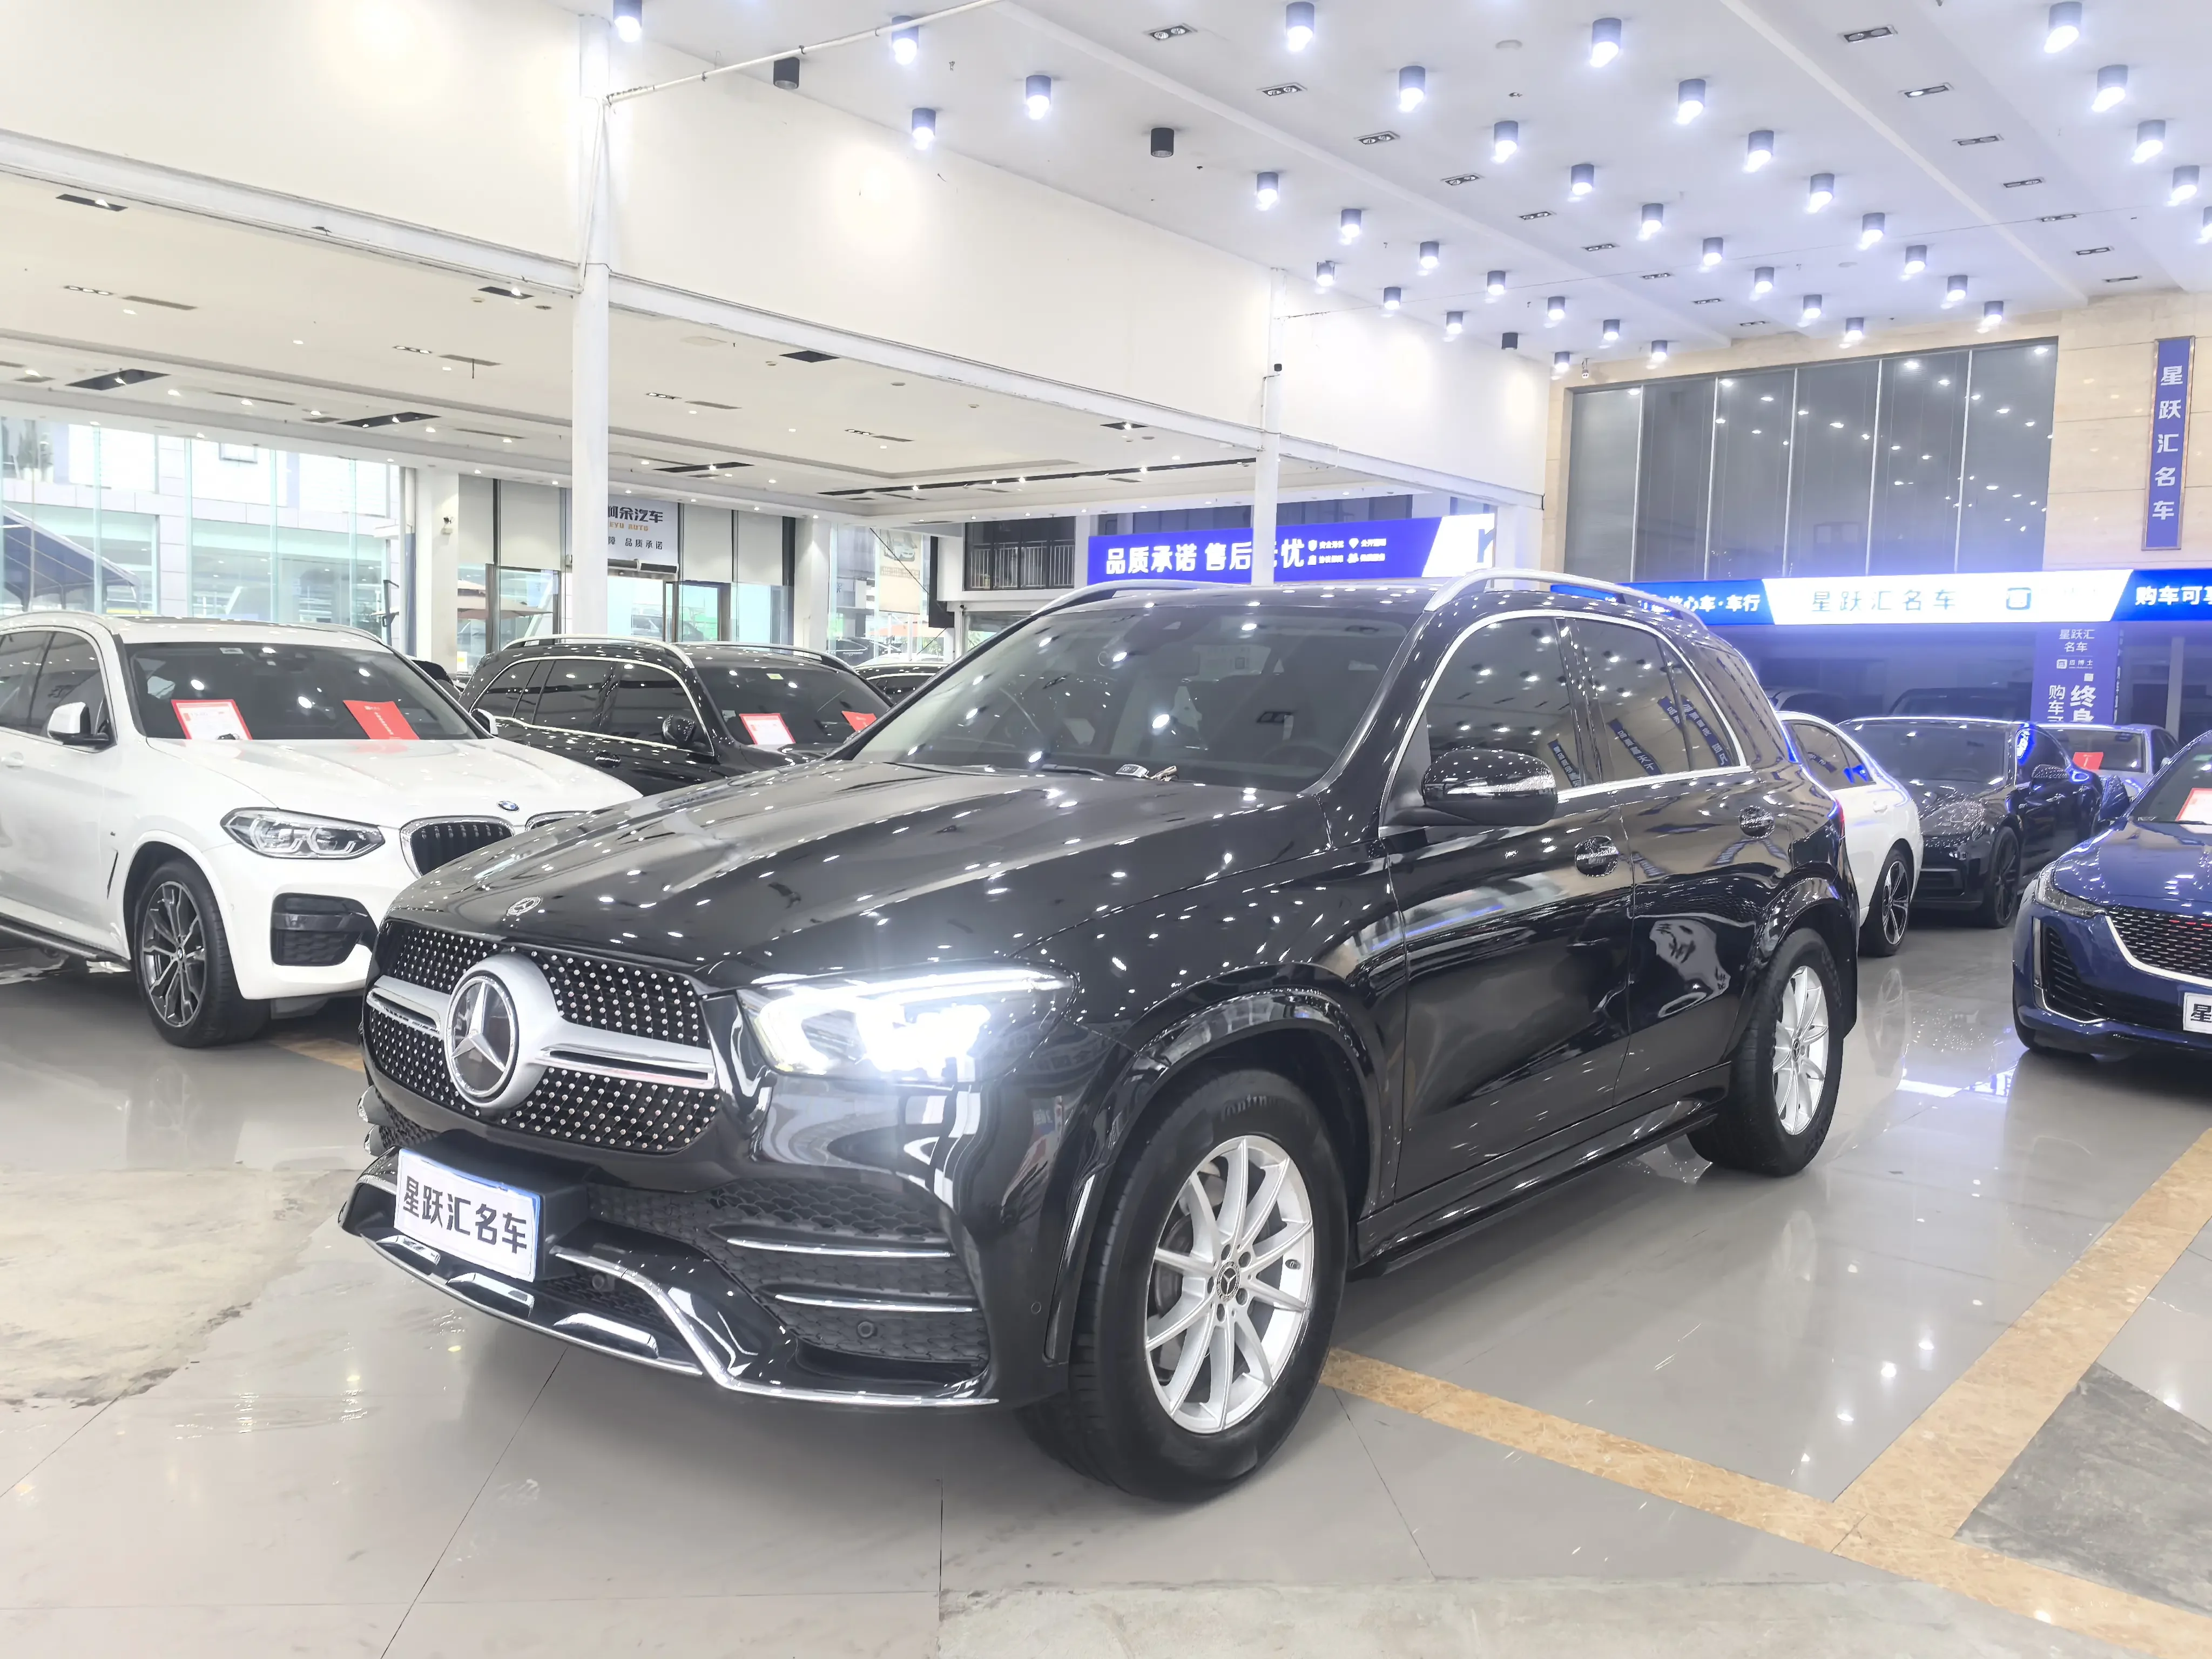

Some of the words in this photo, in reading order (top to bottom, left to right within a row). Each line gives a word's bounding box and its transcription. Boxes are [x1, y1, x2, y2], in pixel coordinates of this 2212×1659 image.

[2152, 366, 2183, 520] 星跃汇名车
[625, 538, 663, 550] 品质承诺
[1106, 543, 1197, 574] 品质承诺
[1205, 538, 1304, 571] 售后忧
[1811, 589, 1956, 612] 星跃汇名车
[2059, 629, 2095, 639] 星跃汇
[2064, 642, 2088, 652] 名车
[2190, 1003, 2212, 1023] 星
[403, 1175, 527, 1254] 星跃汇名车
